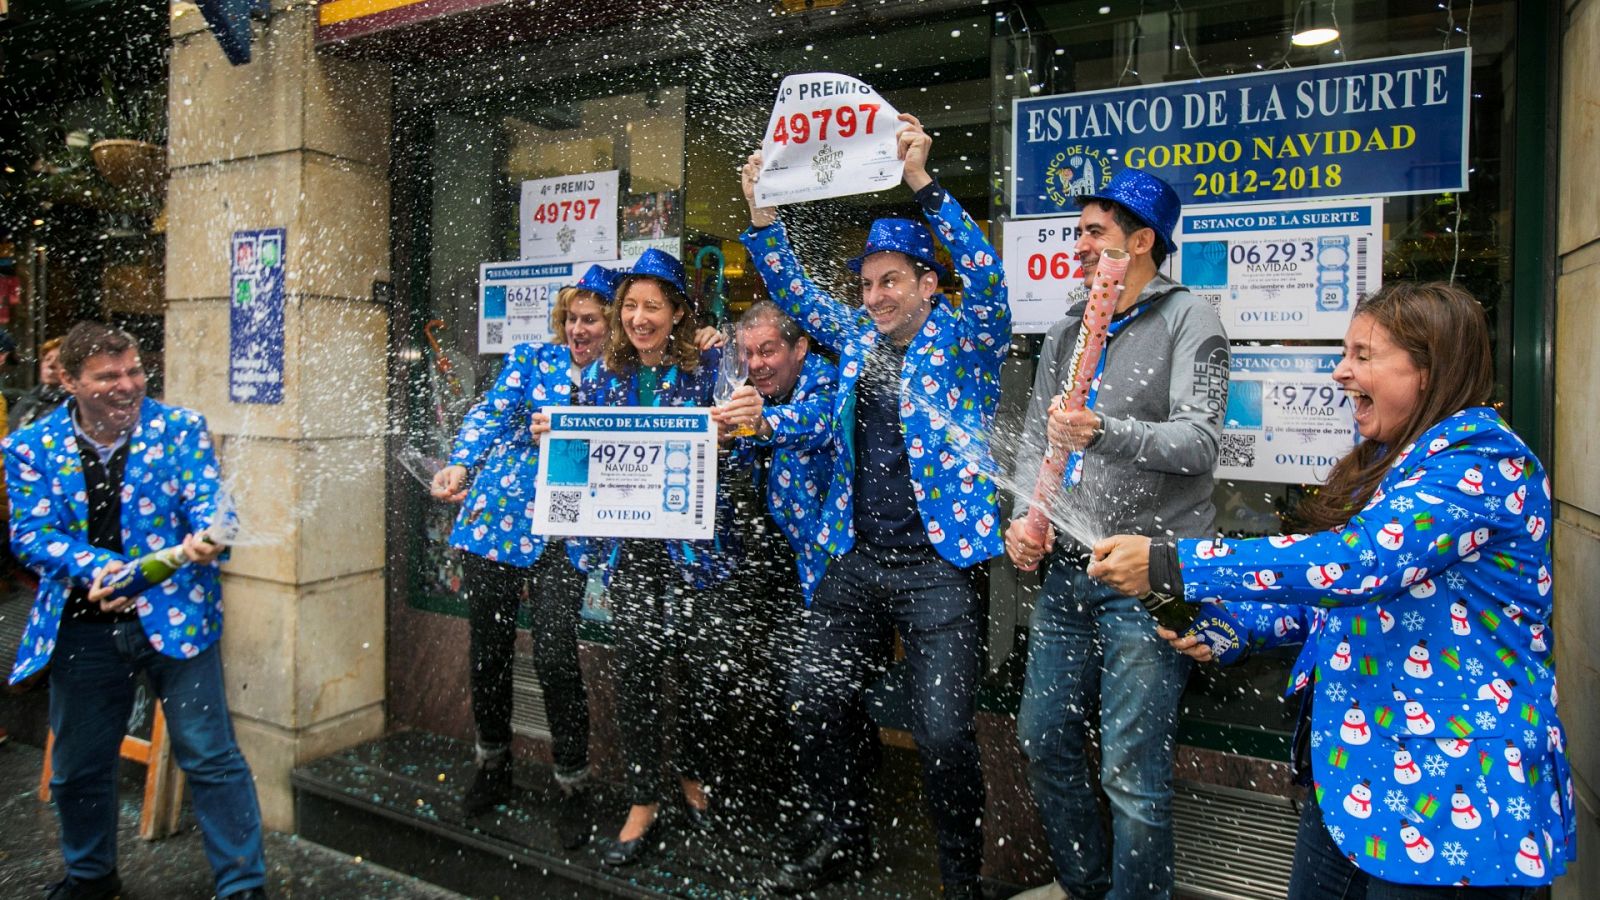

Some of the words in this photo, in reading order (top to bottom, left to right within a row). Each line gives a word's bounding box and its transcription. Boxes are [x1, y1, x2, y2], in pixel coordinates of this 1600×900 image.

[799, 80, 871, 100] PREMIO
[1027, 96, 1173, 143] ESTANCO
[1182, 90, 1228, 129] DE
[1239, 84, 1287, 124] LA
[1296, 65, 1449, 120] SUERTE
[773, 104, 881, 146] 49797
[1124, 139, 1242, 169] GORDO
[1252, 124, 1416, 161] NAVIDAD
[1045, 152, 1066, 207] ESTANCO
[1067, 145, 1082, 156] DE
[1085, 146, 1099, 159] LA
[1193, 163, 1342, 196] 2012-2018
[554, 180, 595, 194] PREMIO
[534, 198, 601, 224] 49797
[1193, 216, 1255, 230] ESTANCO
[1258, 215, 1277, 226] DE
[1281, 214, 1299, 225] LA
[1302, 211, 1359, 224] SUERTE
[623, 245, 644, 256] Foto
[1230, 242, 1314, 264] 06293
[1246, 262, 1297, 272] NAVIDAD
[508, 286, 547, 302] 66212
[1240, 311, 1303, 322] OVIEDO
[1295, 358, 1314, 369] DE
[1192, 363, 1208, 396] THE
[1207, 365, 1221, 425] NORTH
[1220, 367, 1230, 413] FACE
[1282, 406, 1335, 417] NAVIDAD
[560, 415, 613, 428] ESTANCO
[616, 417, 632, 428] DE
[635, 417, 650, 428] LA
[653, 417, 699, 429] SUERTE
[591, 444, 662, 465] 49797
[1275, 453, 1339, 467] OVIEDO
[605, 464, 648, 473] NAVIDAD
[607, 482, 636, 490] diciembre
[597, 509, 651, 521] OVIEDO
[1211, 617, 1240, 649] SUERTE
